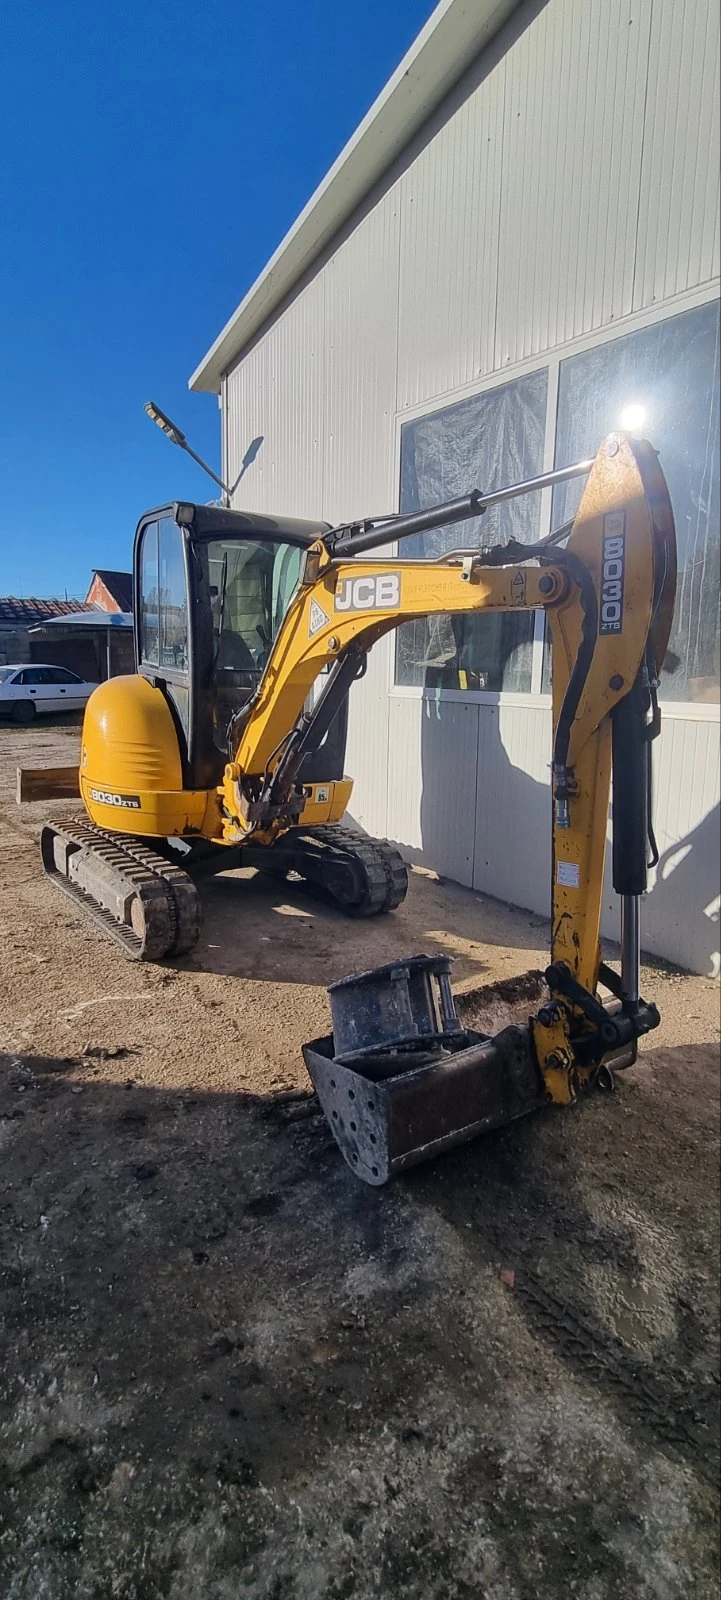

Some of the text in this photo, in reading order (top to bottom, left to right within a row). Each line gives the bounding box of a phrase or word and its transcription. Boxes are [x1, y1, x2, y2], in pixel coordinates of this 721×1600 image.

[335, 575, 400, 610] JCB
[602, 537, 624, 622] 8030
[601, 622, 621, 630] ZTS
[91, 789, 122, 806] 8030
